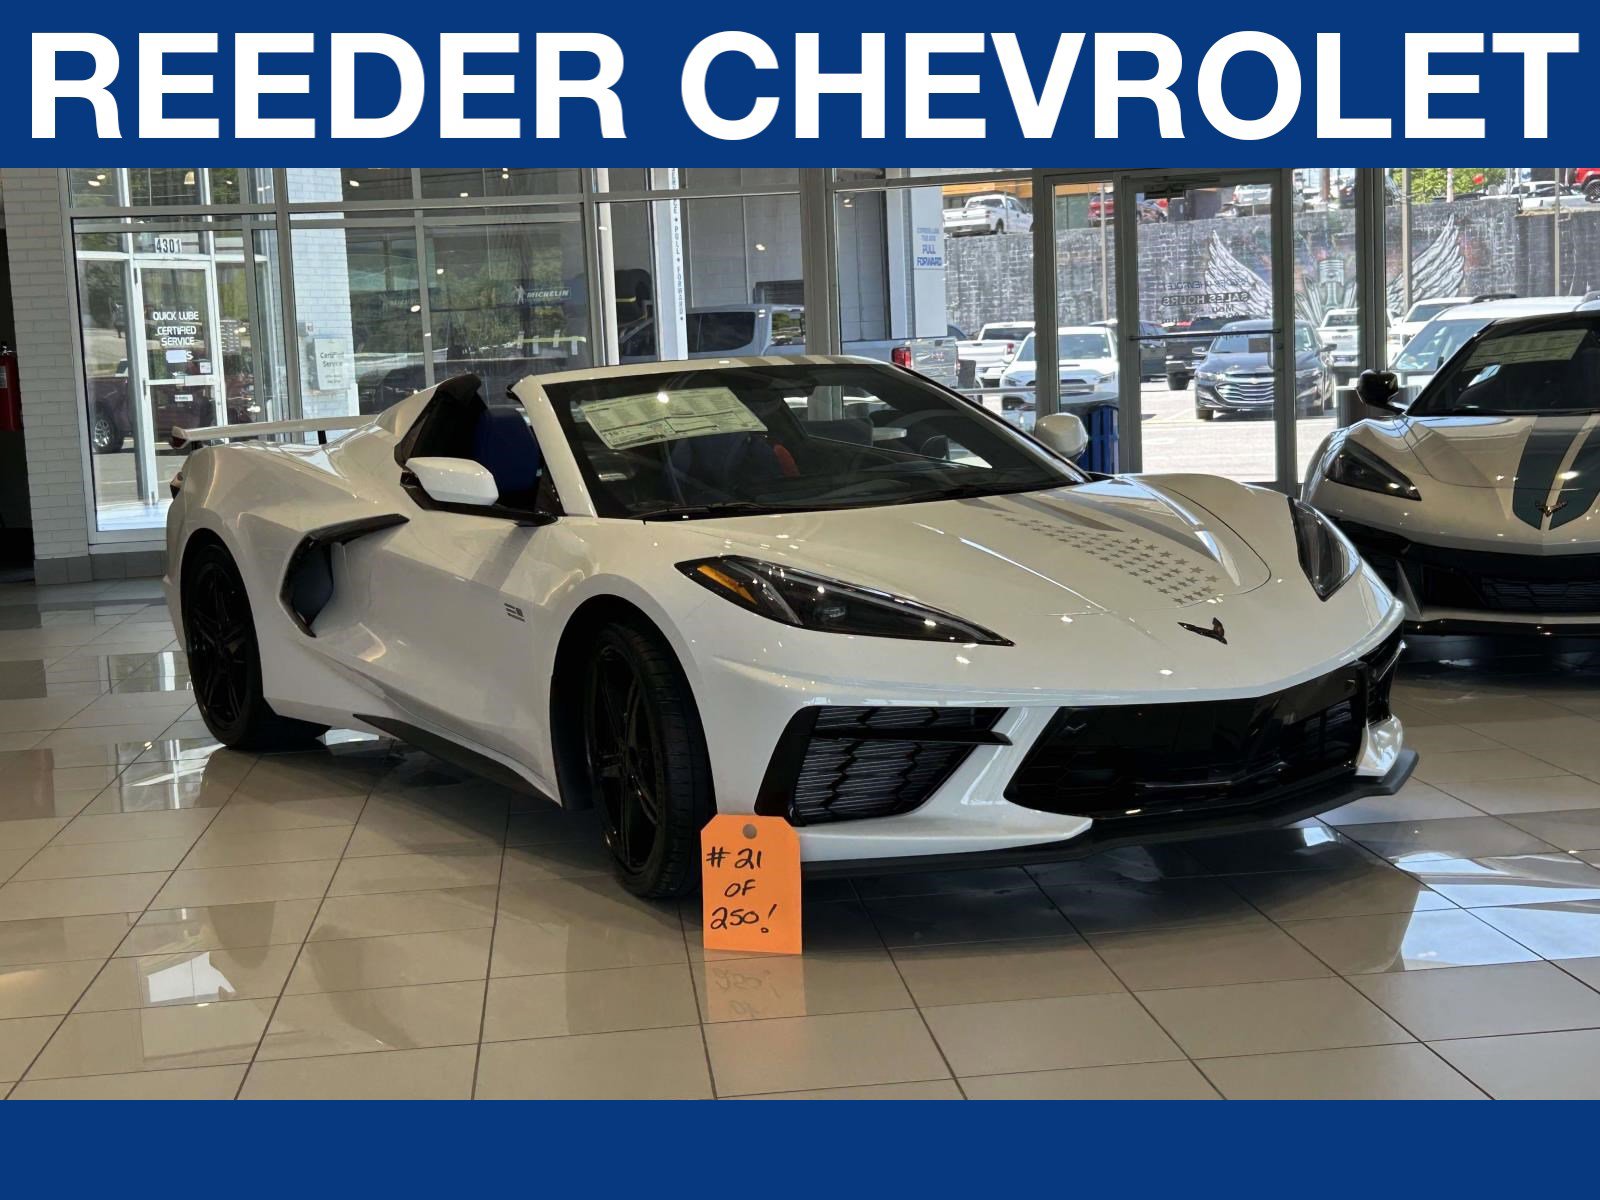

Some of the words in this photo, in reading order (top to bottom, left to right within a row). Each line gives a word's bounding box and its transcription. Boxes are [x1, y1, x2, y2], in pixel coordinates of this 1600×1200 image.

[156, 238, 181, 253] 4301
[922, 244, 936, 255] PULL
[916, 256, 943, 267] FORWARD
[527, 289, 569, 299] MICHELIN
[153, 311, 177, 321] QUICK
[179, 311, 199, 320] LUBE
[157, 325, 197, 336] CERTIFIED
[161, 337, 195, 347] SERVICE
[710, 903, 778, 934] 250!
